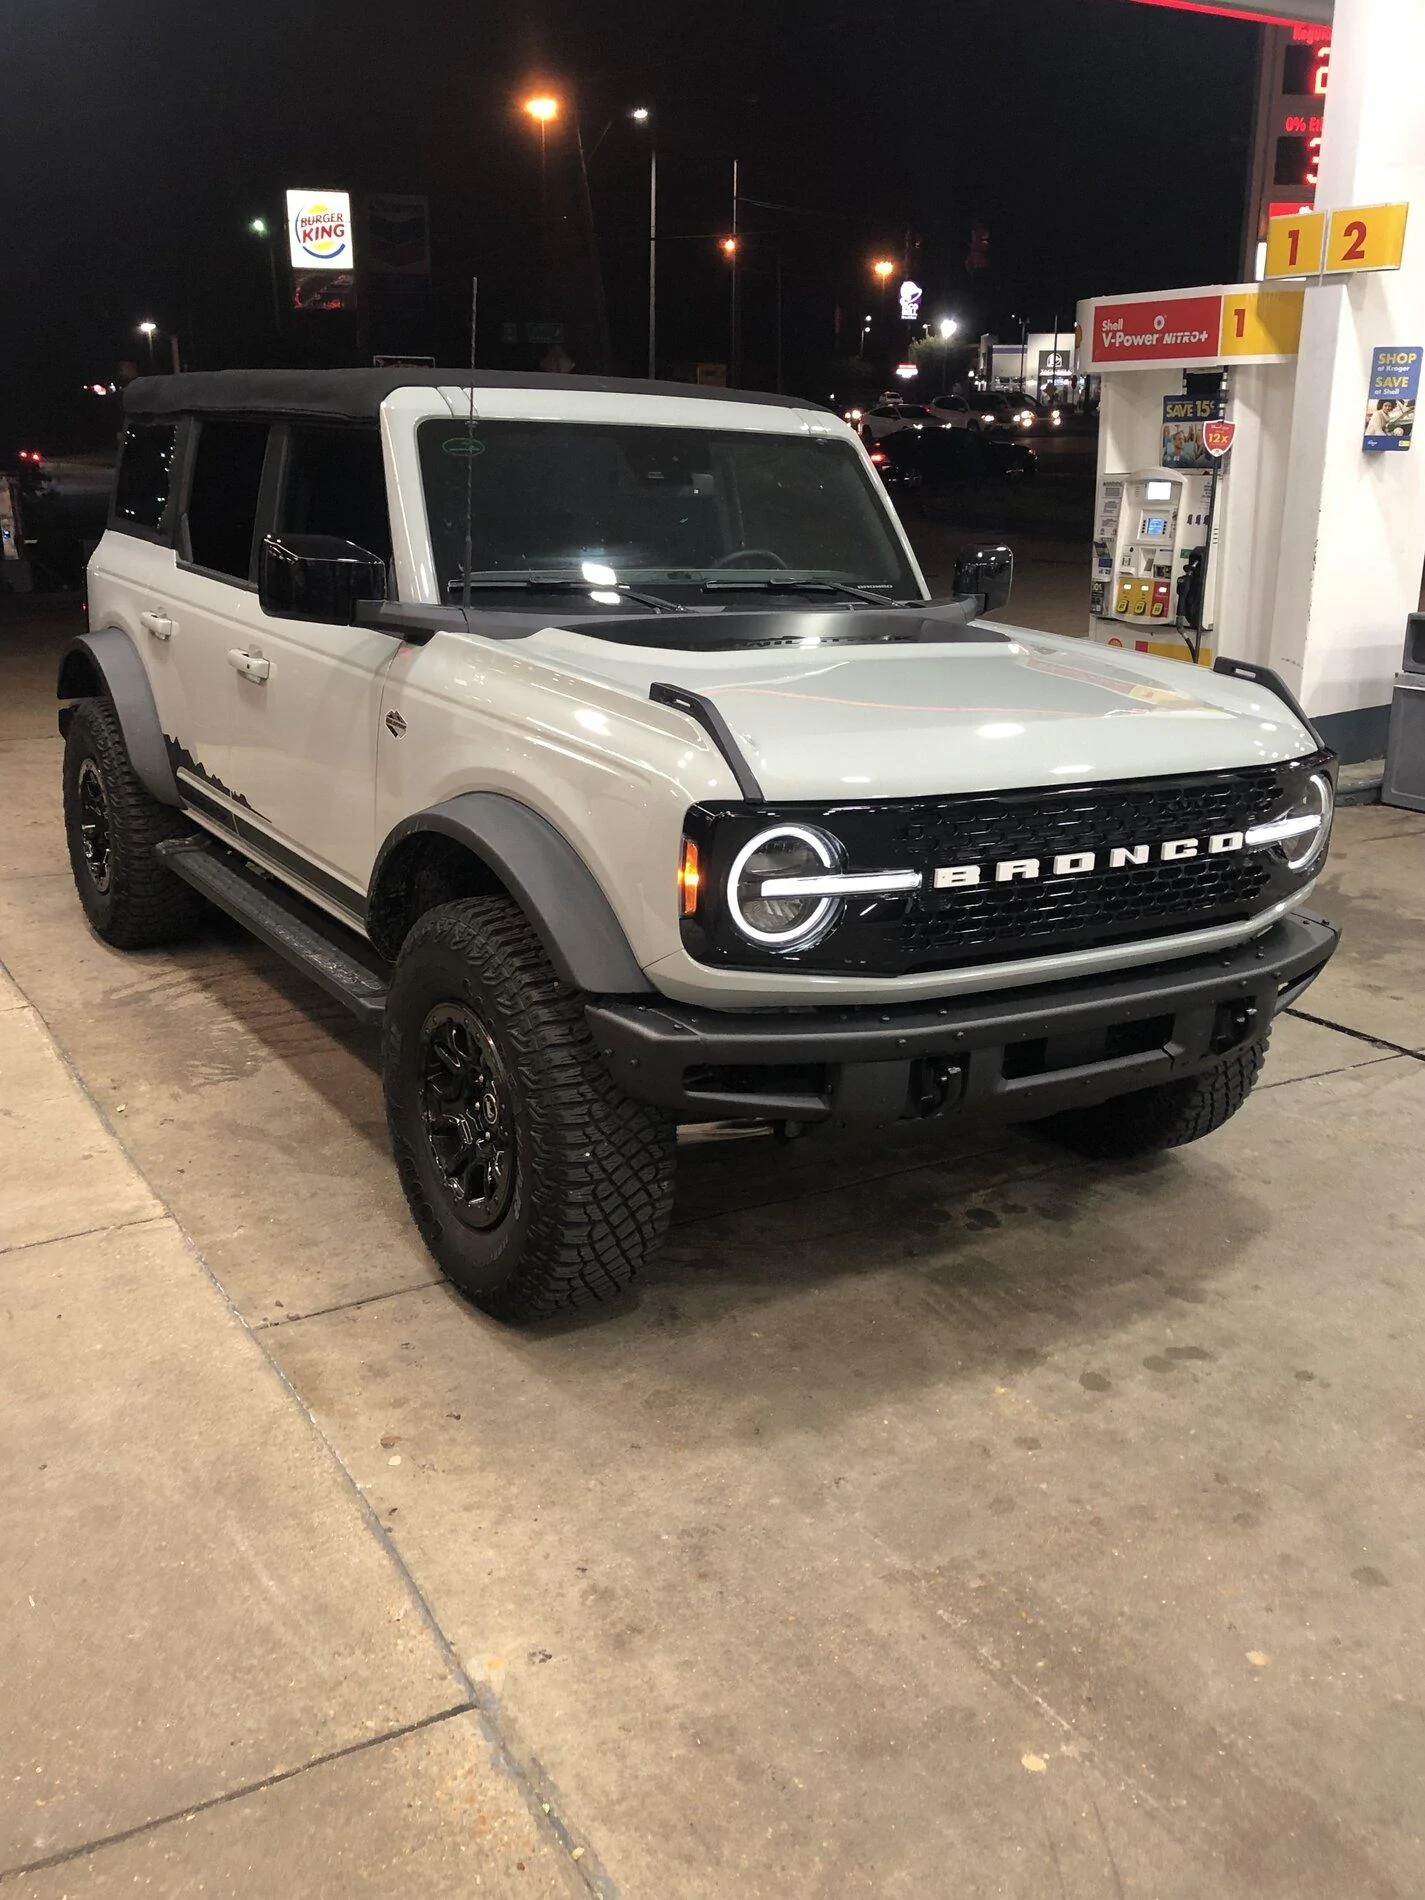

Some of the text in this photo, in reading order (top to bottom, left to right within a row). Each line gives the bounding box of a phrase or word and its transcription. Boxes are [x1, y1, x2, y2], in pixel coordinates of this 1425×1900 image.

[301, 213, 344, 228] BURGER
[303, 223, 345, 243] KING
[1341, 220, 1367, 261] 2
[1288, 229, 1300, 266] 1
[1102, 318, 1124, 331] Shell
[1234, 309, 1246, 337] 1
[1102, 331, 1159, 348] V-Power
[1378, 352, 1417, 365] SHOP
[1386, 365, 1410, 373] Kroger
[1374, 376, 1410, 388] SAVE
[1166, 404, 1194, 417] SAVE
[933, 831, 1244, 889] BRONCO
